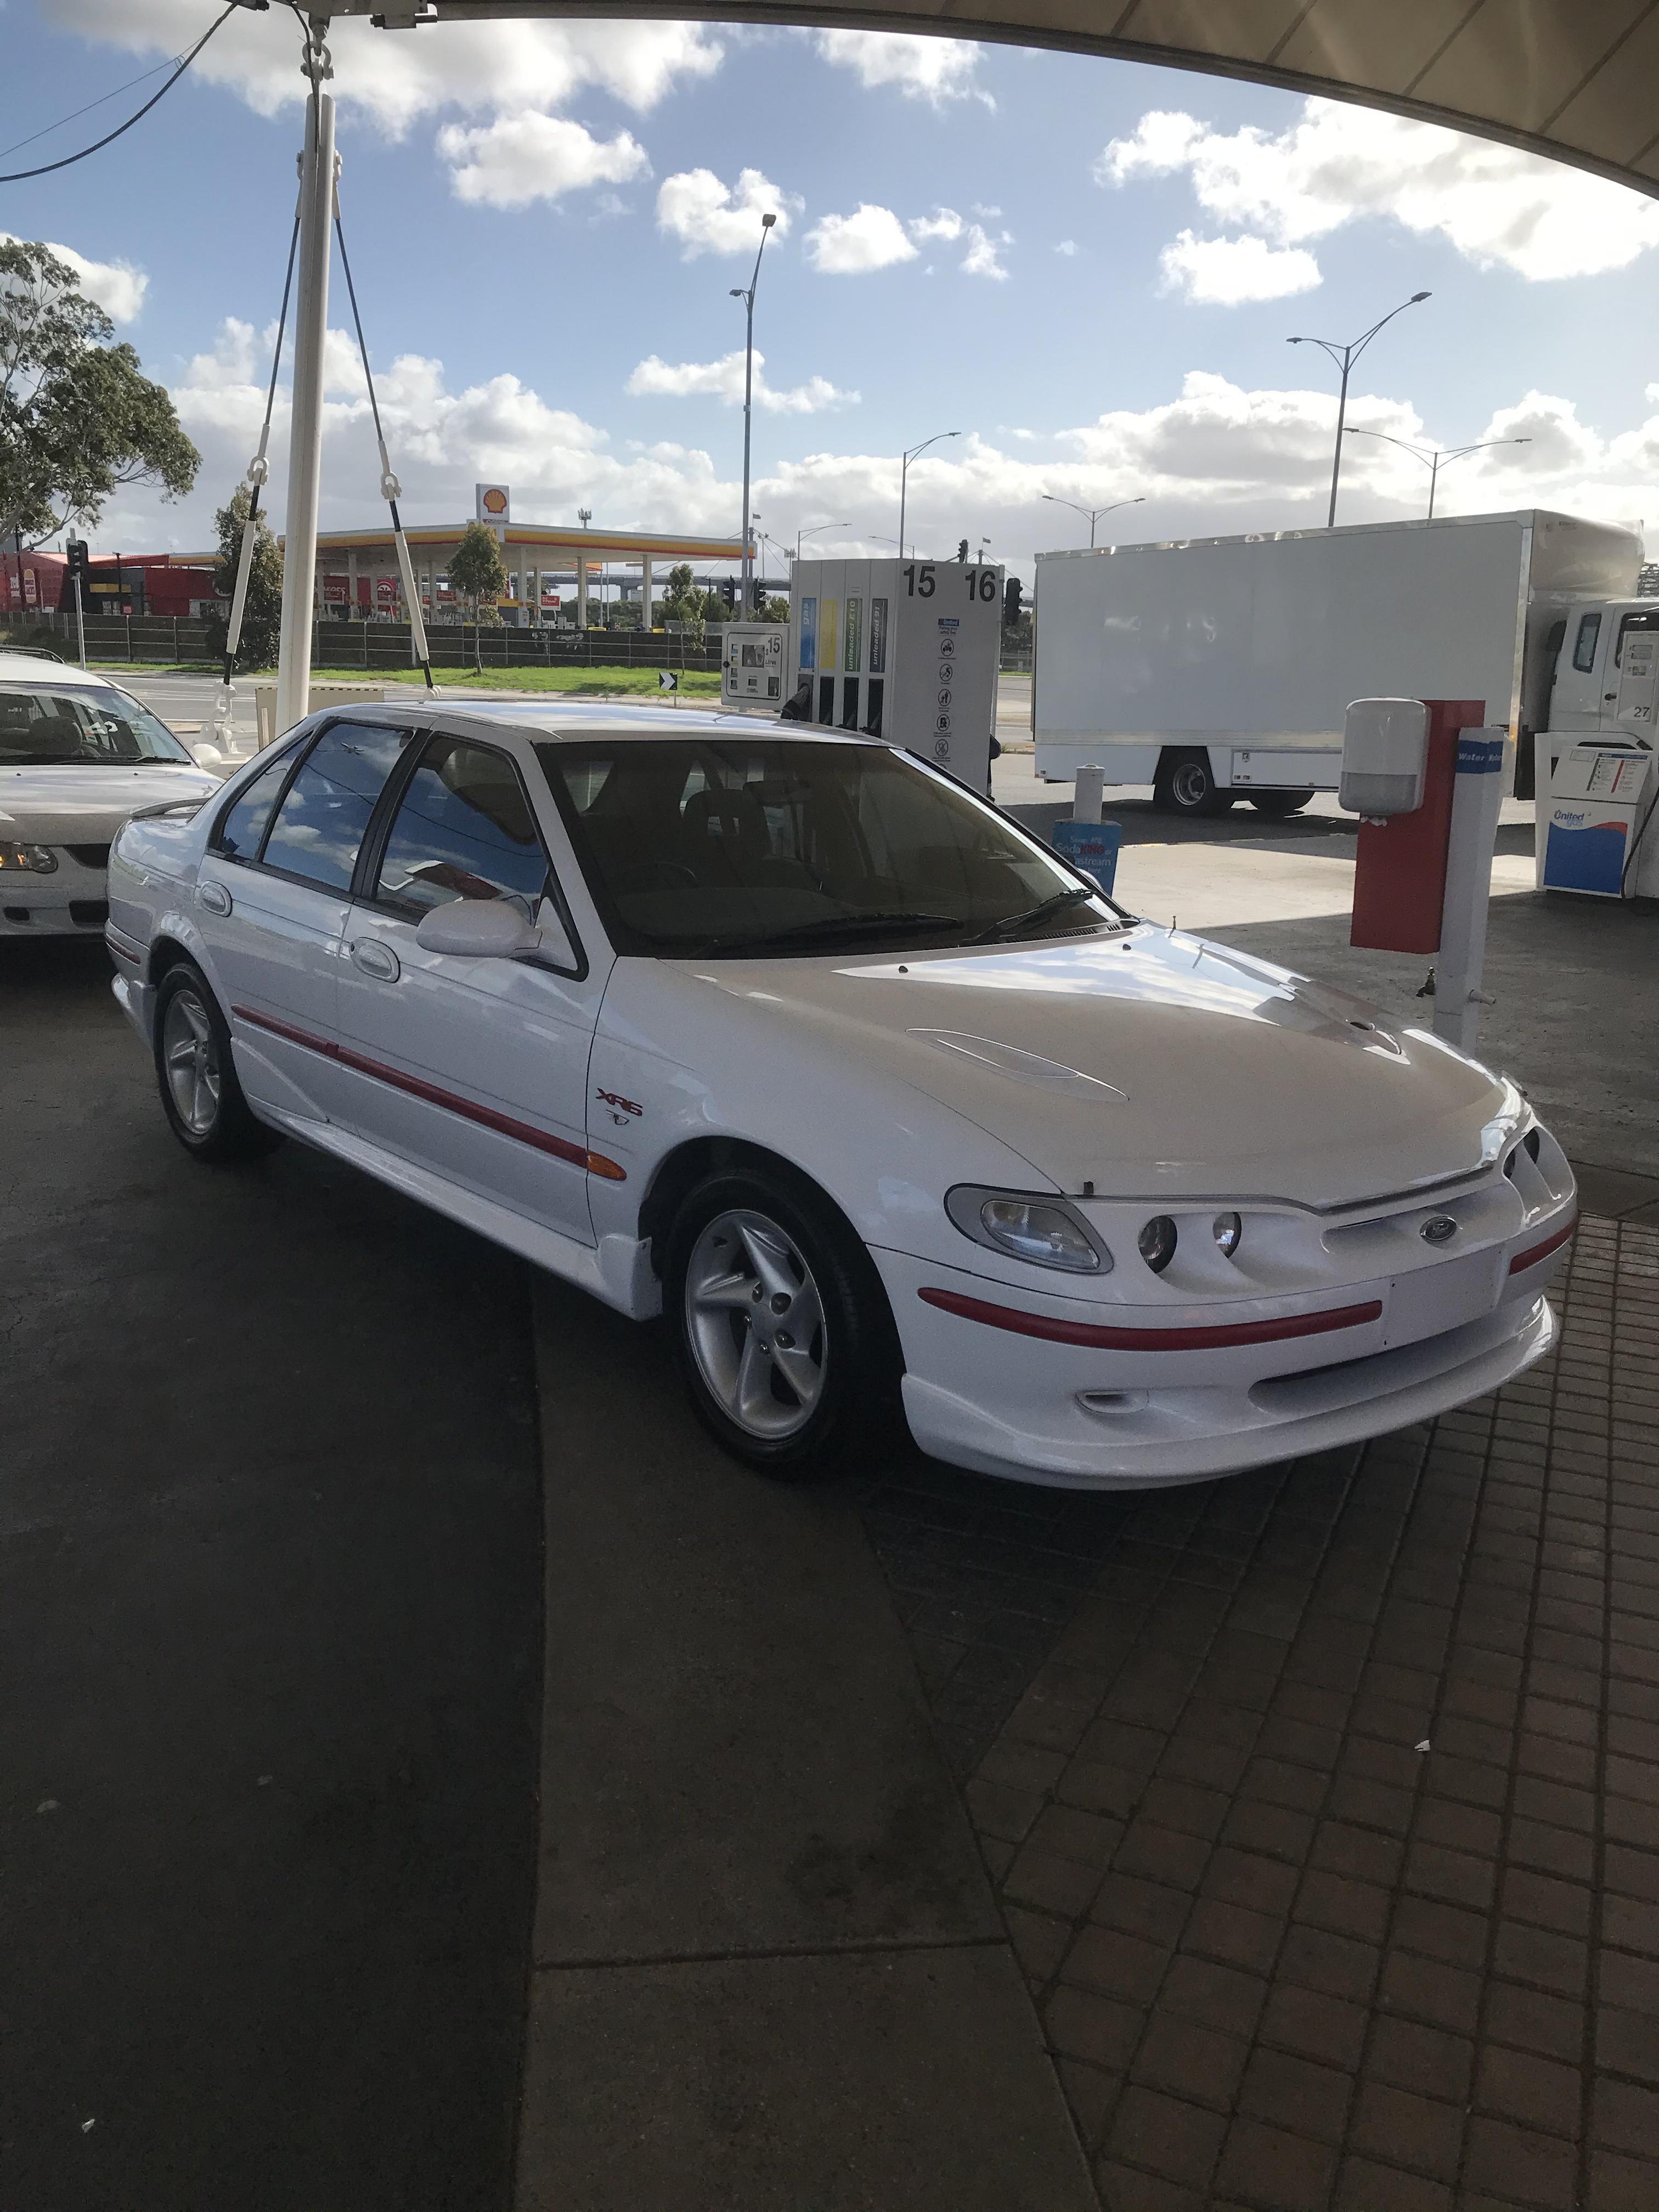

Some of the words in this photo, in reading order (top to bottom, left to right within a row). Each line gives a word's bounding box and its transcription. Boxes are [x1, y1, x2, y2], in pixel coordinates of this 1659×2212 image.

[903, 565, 936, 598] 15
[965, 569, 996, 602] 16
[874, 606, 880, 617] 91
[768, 637, 780, 653] 15
[1633, 706, 1650, 718] 27
[1554, 809, 1585, 820] United
[1056, 843, 1104, 854] SodaKING
[595, 1087, 643, 1116] XR6
